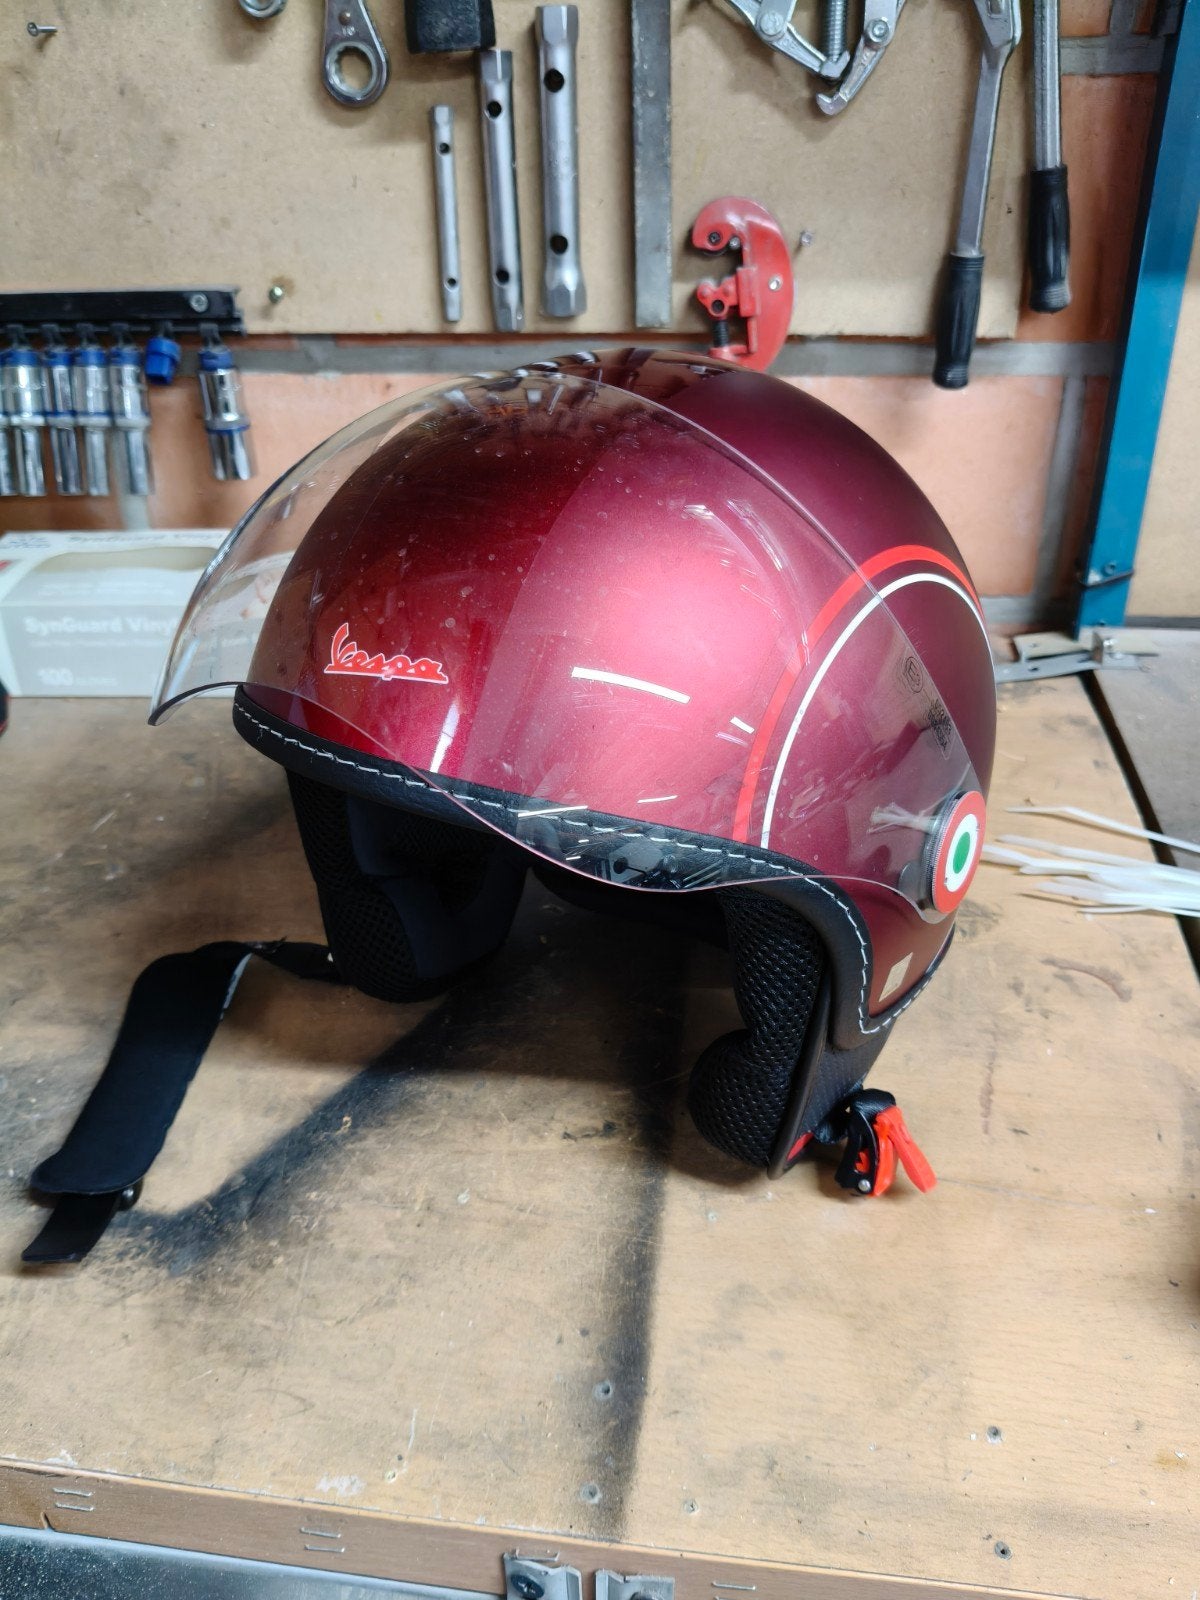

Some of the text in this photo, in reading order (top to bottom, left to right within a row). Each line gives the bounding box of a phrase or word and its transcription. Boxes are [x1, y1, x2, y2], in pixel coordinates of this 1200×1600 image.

[23, 616, 122, 637] SynGuard
[324, 622, 449, 684] Vespa
[37, 667, 75, 687] 100
